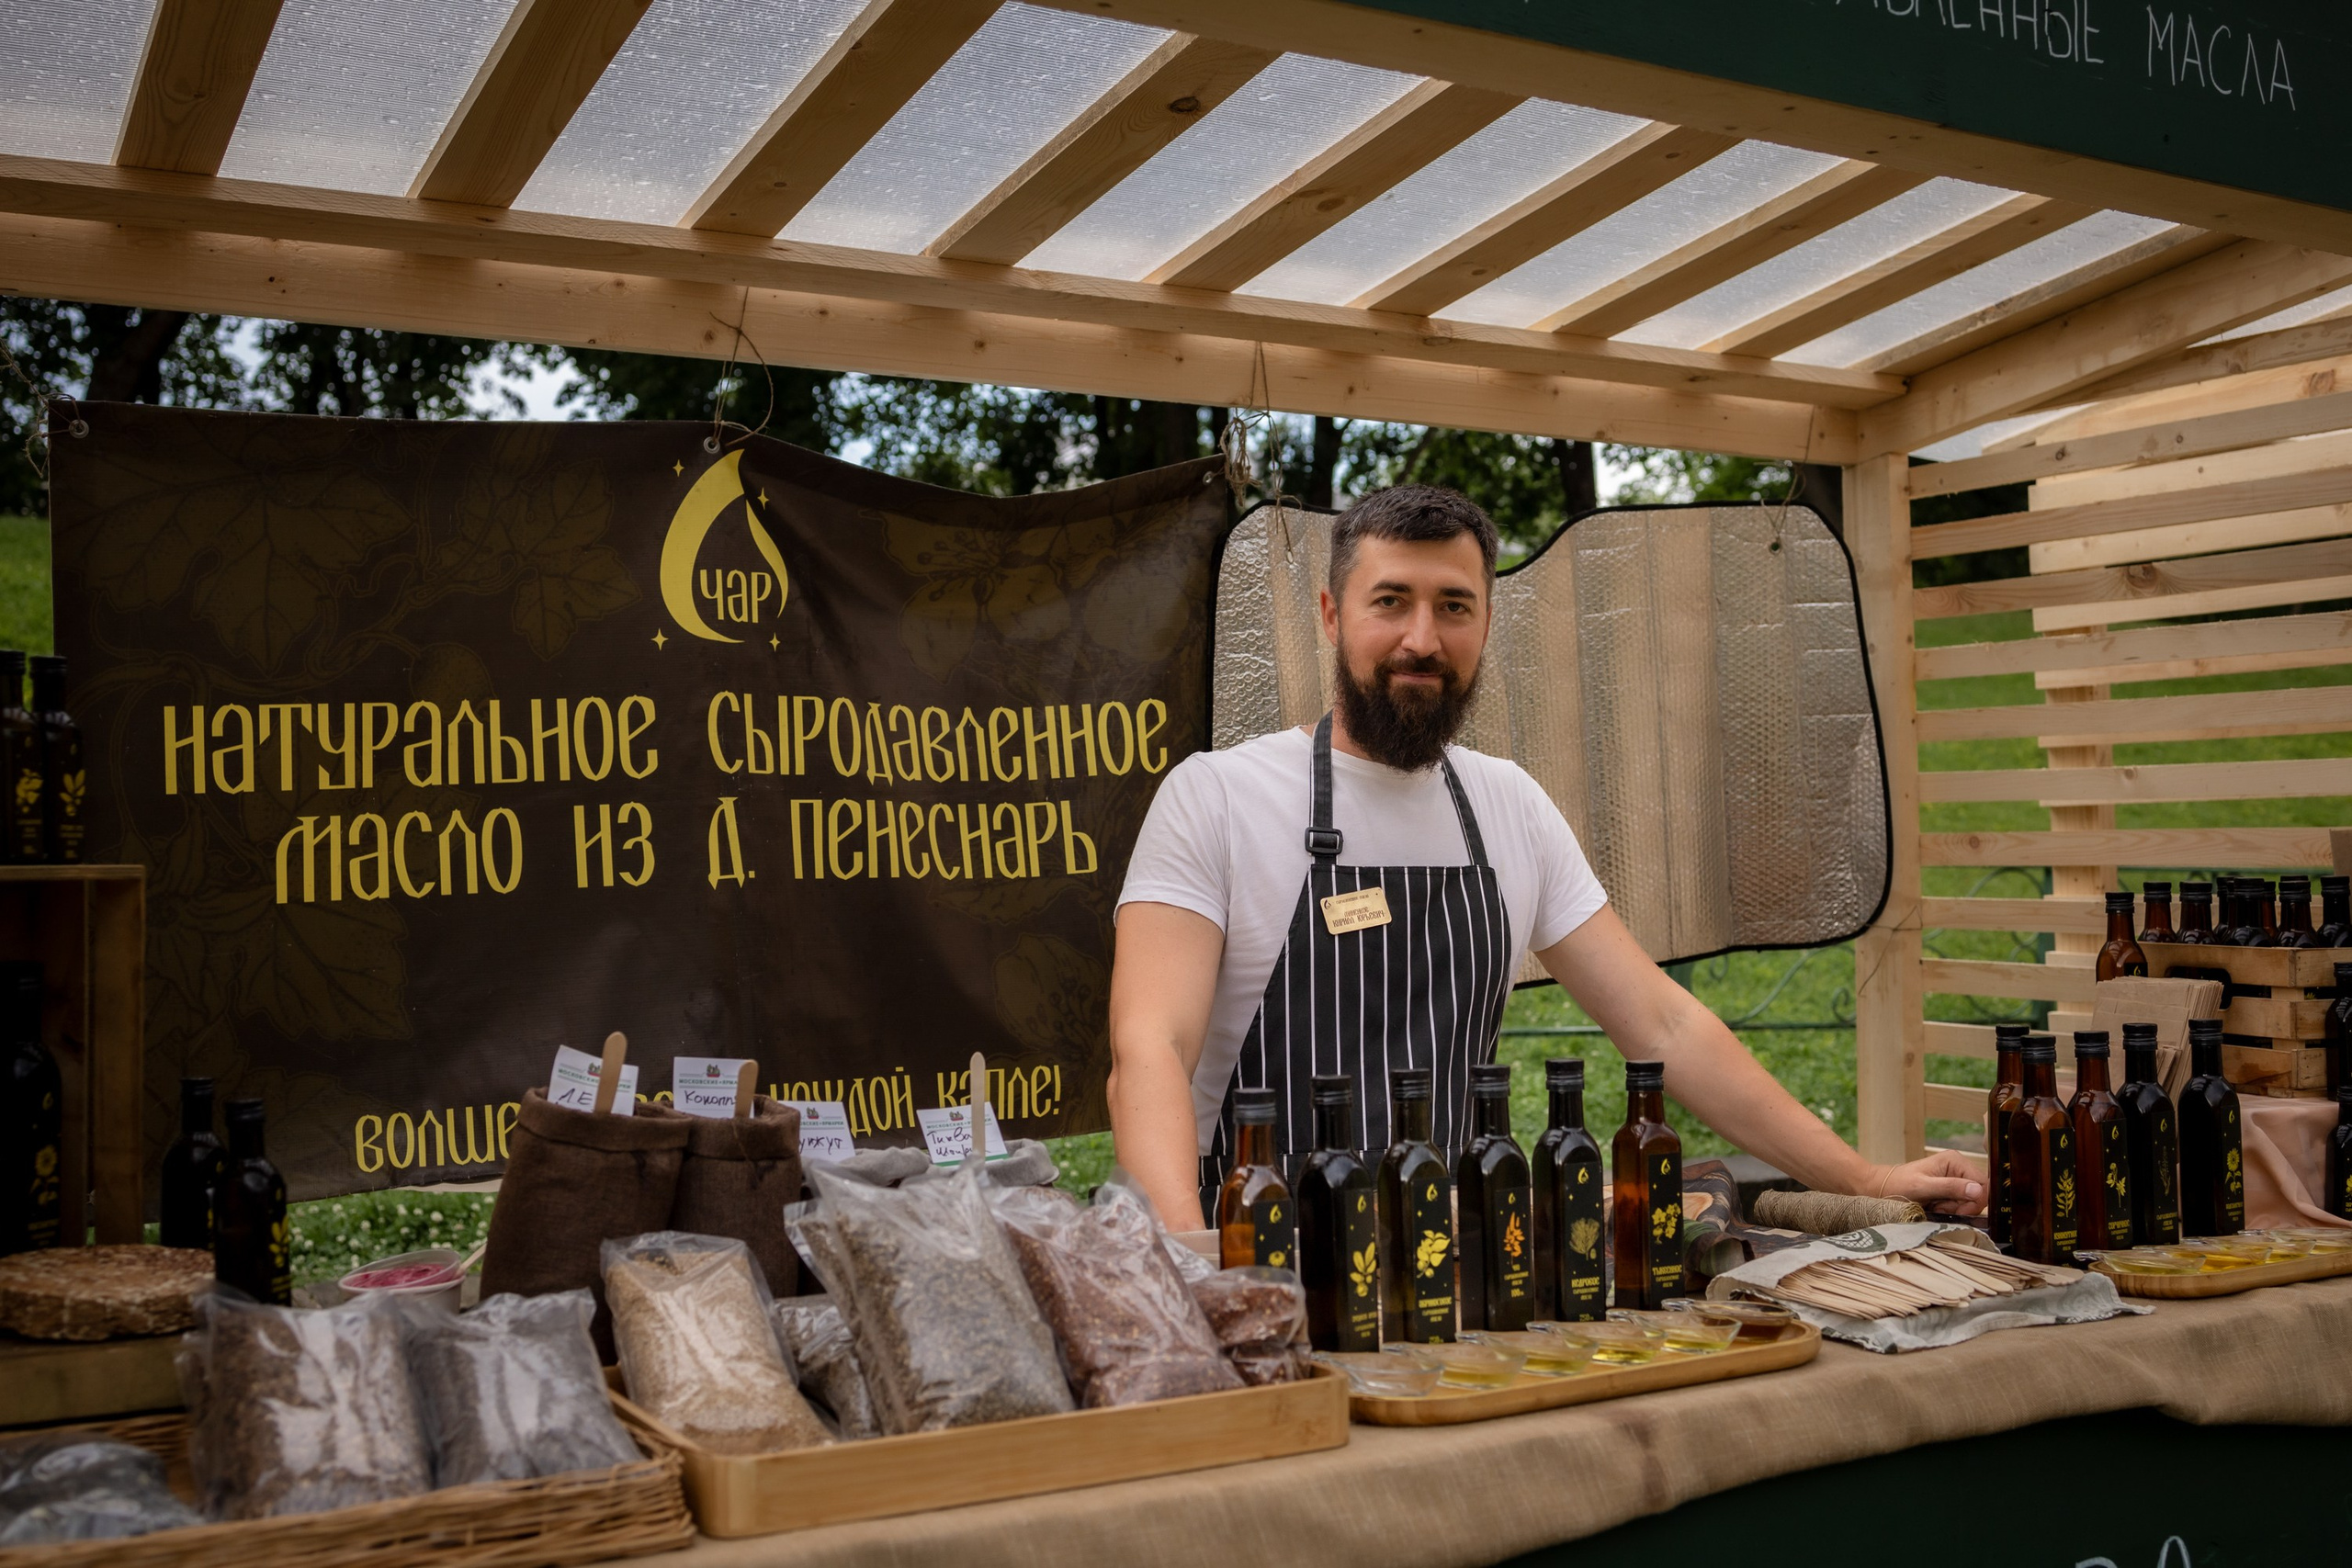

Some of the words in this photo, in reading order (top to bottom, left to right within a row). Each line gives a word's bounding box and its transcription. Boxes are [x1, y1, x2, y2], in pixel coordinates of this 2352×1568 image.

[2146, 5, 2296, 111] МАСЛА
[699, 569, 772, 624] ЧАР
[164, 694, 659, 795] НАТУРАЛЬНОЕ
[707, 690, 1168, 787] СЫРОДАВЛЕННОЕ
[276, 806, 523, 905] МАСЛО
[573, 801, 655, 888] ИЗ
[707, 796, 756, 890] Д.
[790, 797, 1098, 880] ПЕНЕСНАРЬ
[559, 1088, 593, 1105] ЛЕ
[684, 1089, 737, 1106] Конопл
